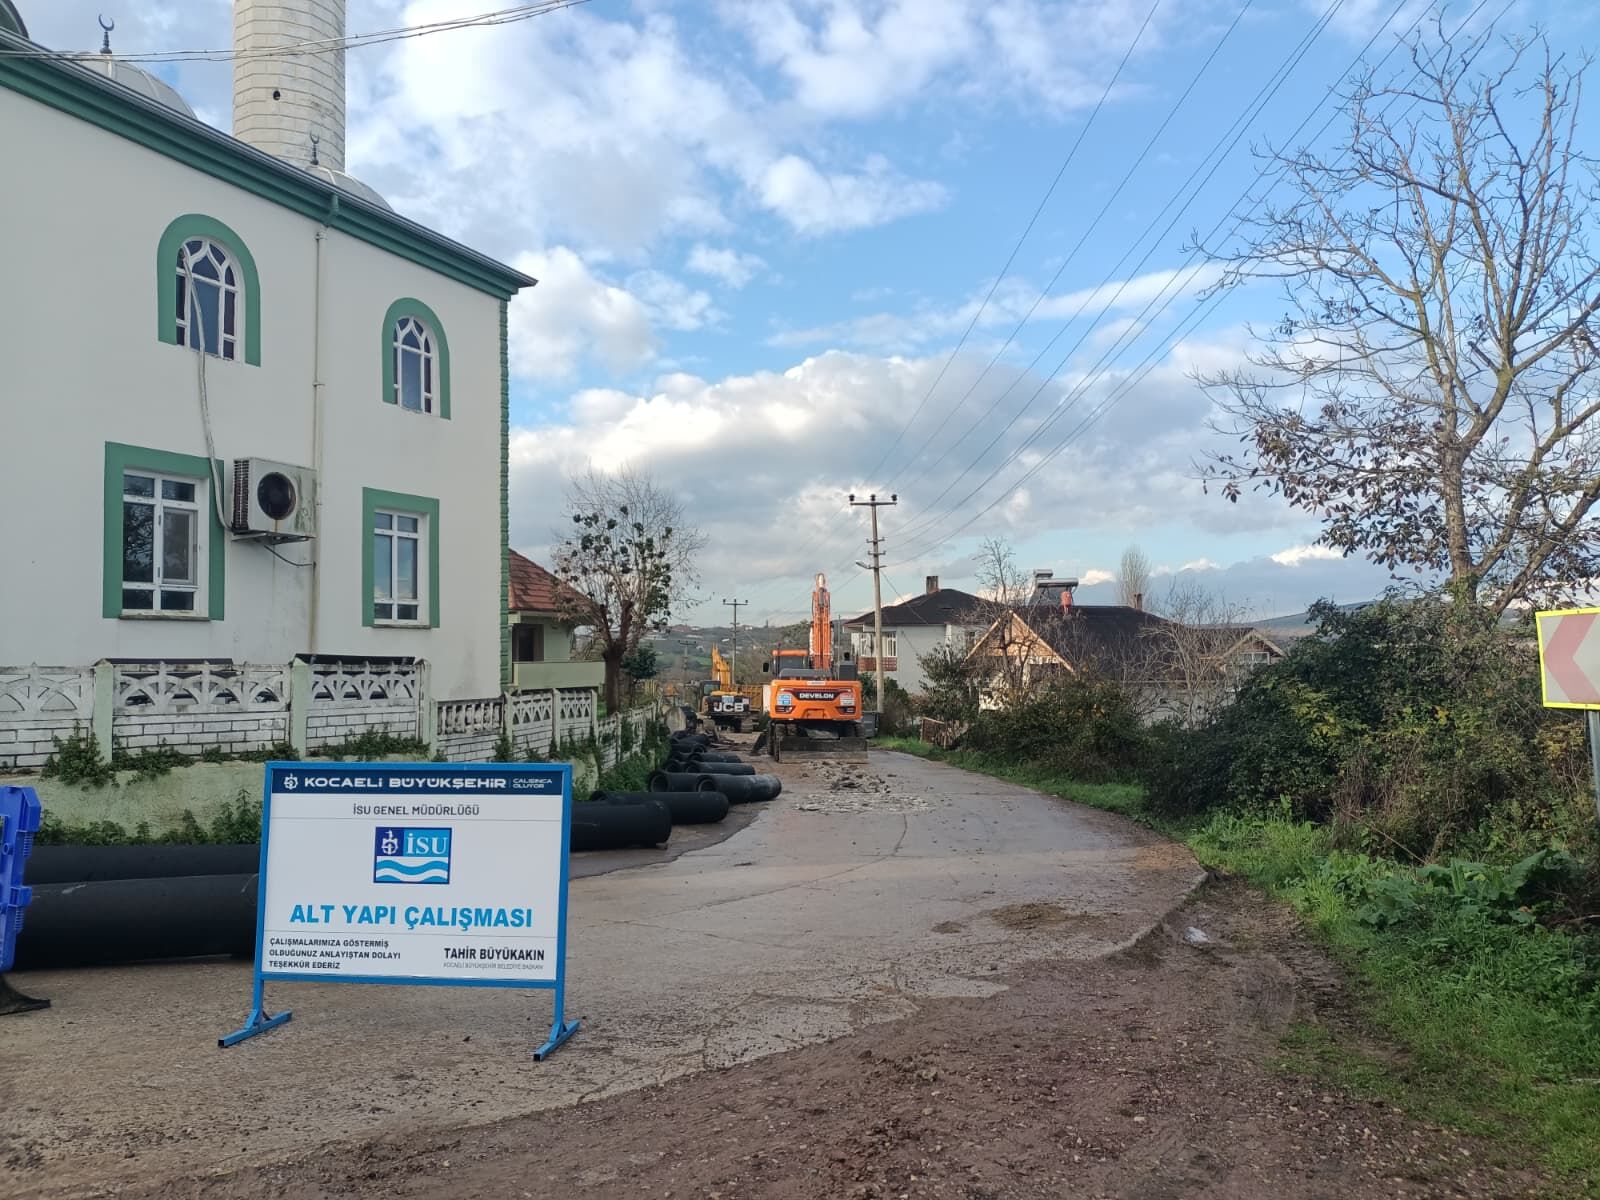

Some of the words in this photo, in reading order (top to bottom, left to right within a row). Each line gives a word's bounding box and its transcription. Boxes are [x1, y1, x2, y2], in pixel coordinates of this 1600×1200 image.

[713, 702, 744, 712] JCB
[353, 803, 371, 815] İSU
[373, 805, 409, 815] GENEL
[412, 804, 480, 815] MÜDÜRLÜĞÜ
[406, 832, 448, 855] İSU
[290, 904, 335, 924] ALT
[342, 905, 396, 925] YAPI
[404, 906, 532, 931] ÇALIŞMASI
[270, 938, 341, 947] ÇALIŞMALARIMIZA
[343, 939, 389, 948] GÖSTERMİŞ
[269, 949, 318, 957] OLDUĞUNUZ
[319, 950, 370, 959] ANLAYIŞTAN
[444, 946, 476, 959] TAHİR
[480, 947, 545, 960] BÜYÜKAKIN
[269, 960, 310, 968] TEŞEKKÜR
[312, 961, 341, 969] EDERİZ
